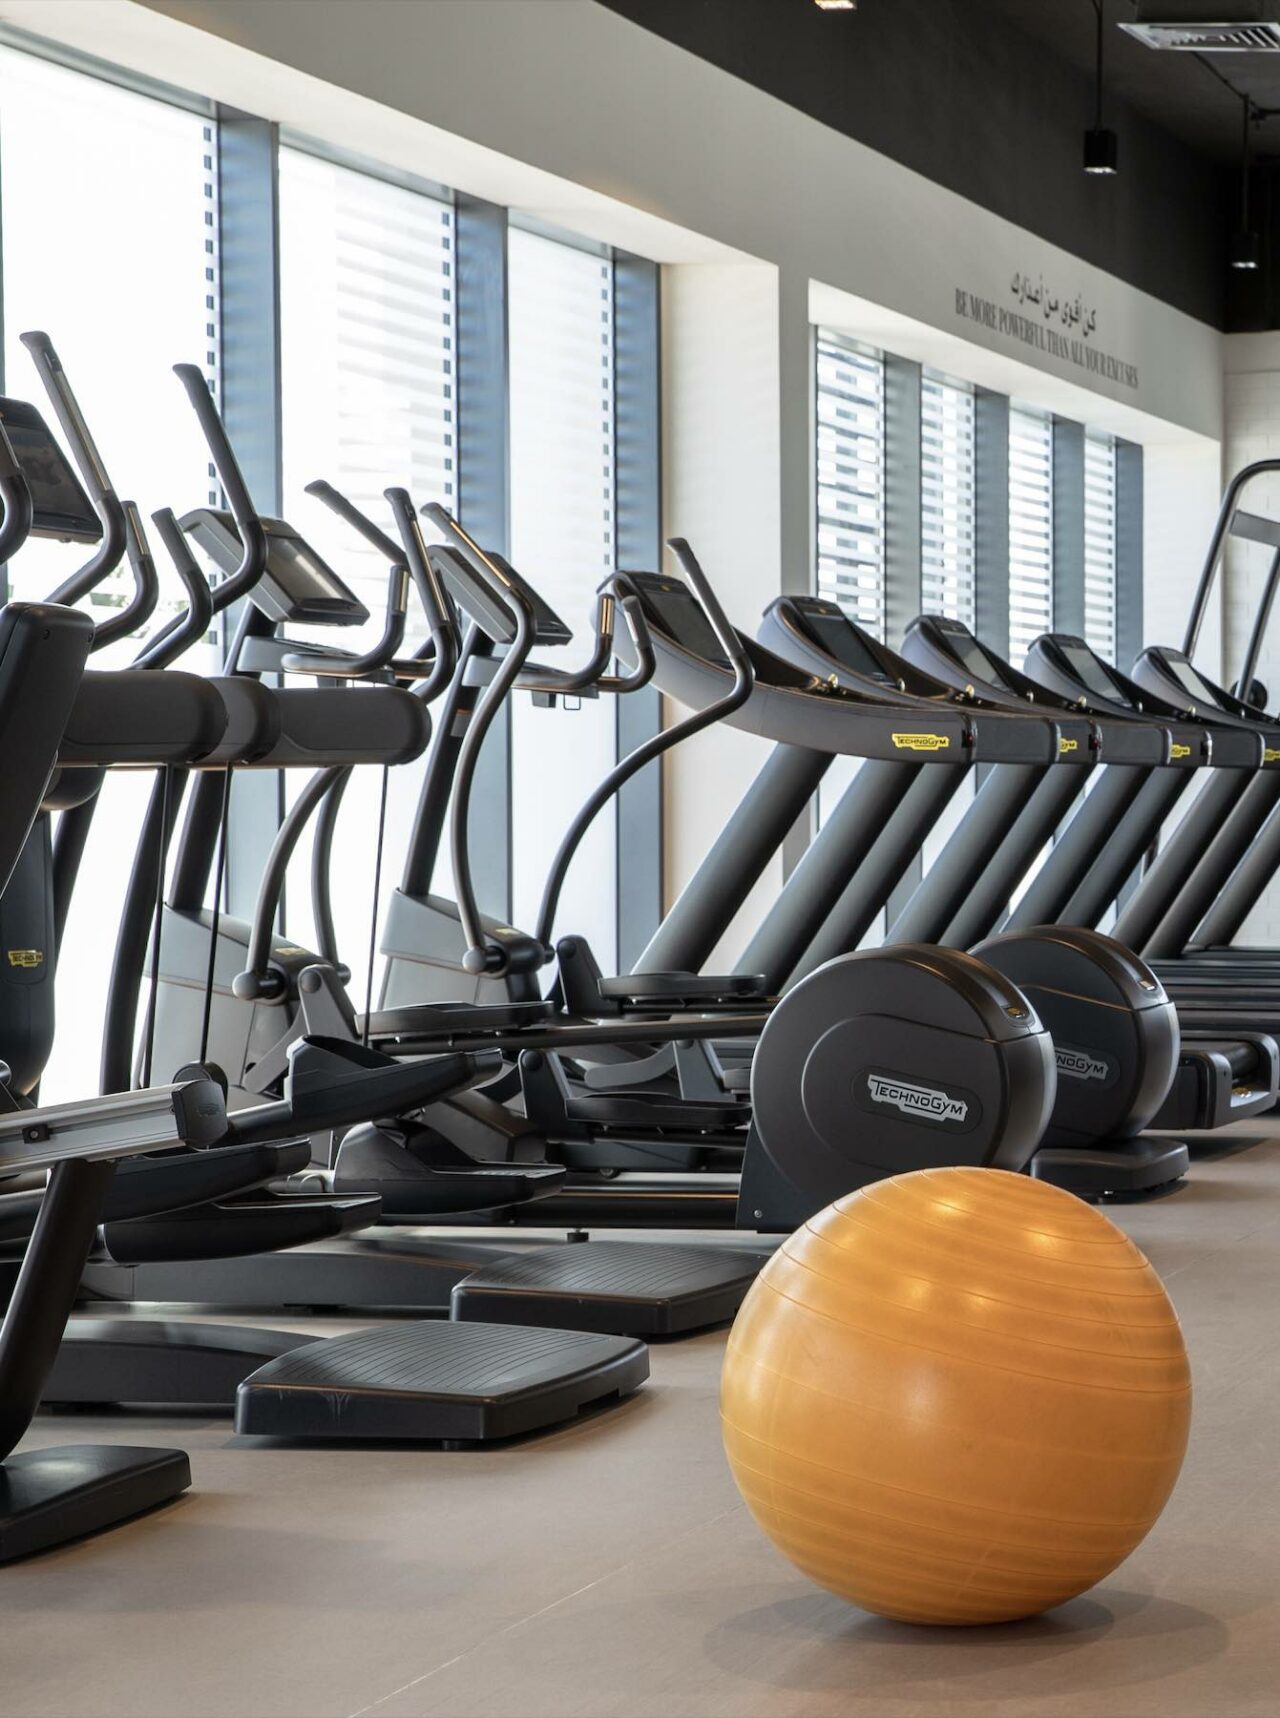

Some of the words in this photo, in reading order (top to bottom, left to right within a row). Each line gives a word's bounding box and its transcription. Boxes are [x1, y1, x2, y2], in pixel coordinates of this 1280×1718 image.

[955, 288, 969, 318] BE
[970, 294, 997, 330] MORE
[998, 307, 1046, 351] POWERFUL
[1047, 329, 1069, 360] THAN
[1070, 340, 1084, 368] ALL
[1084, 346, 1106, 377] YOUR
